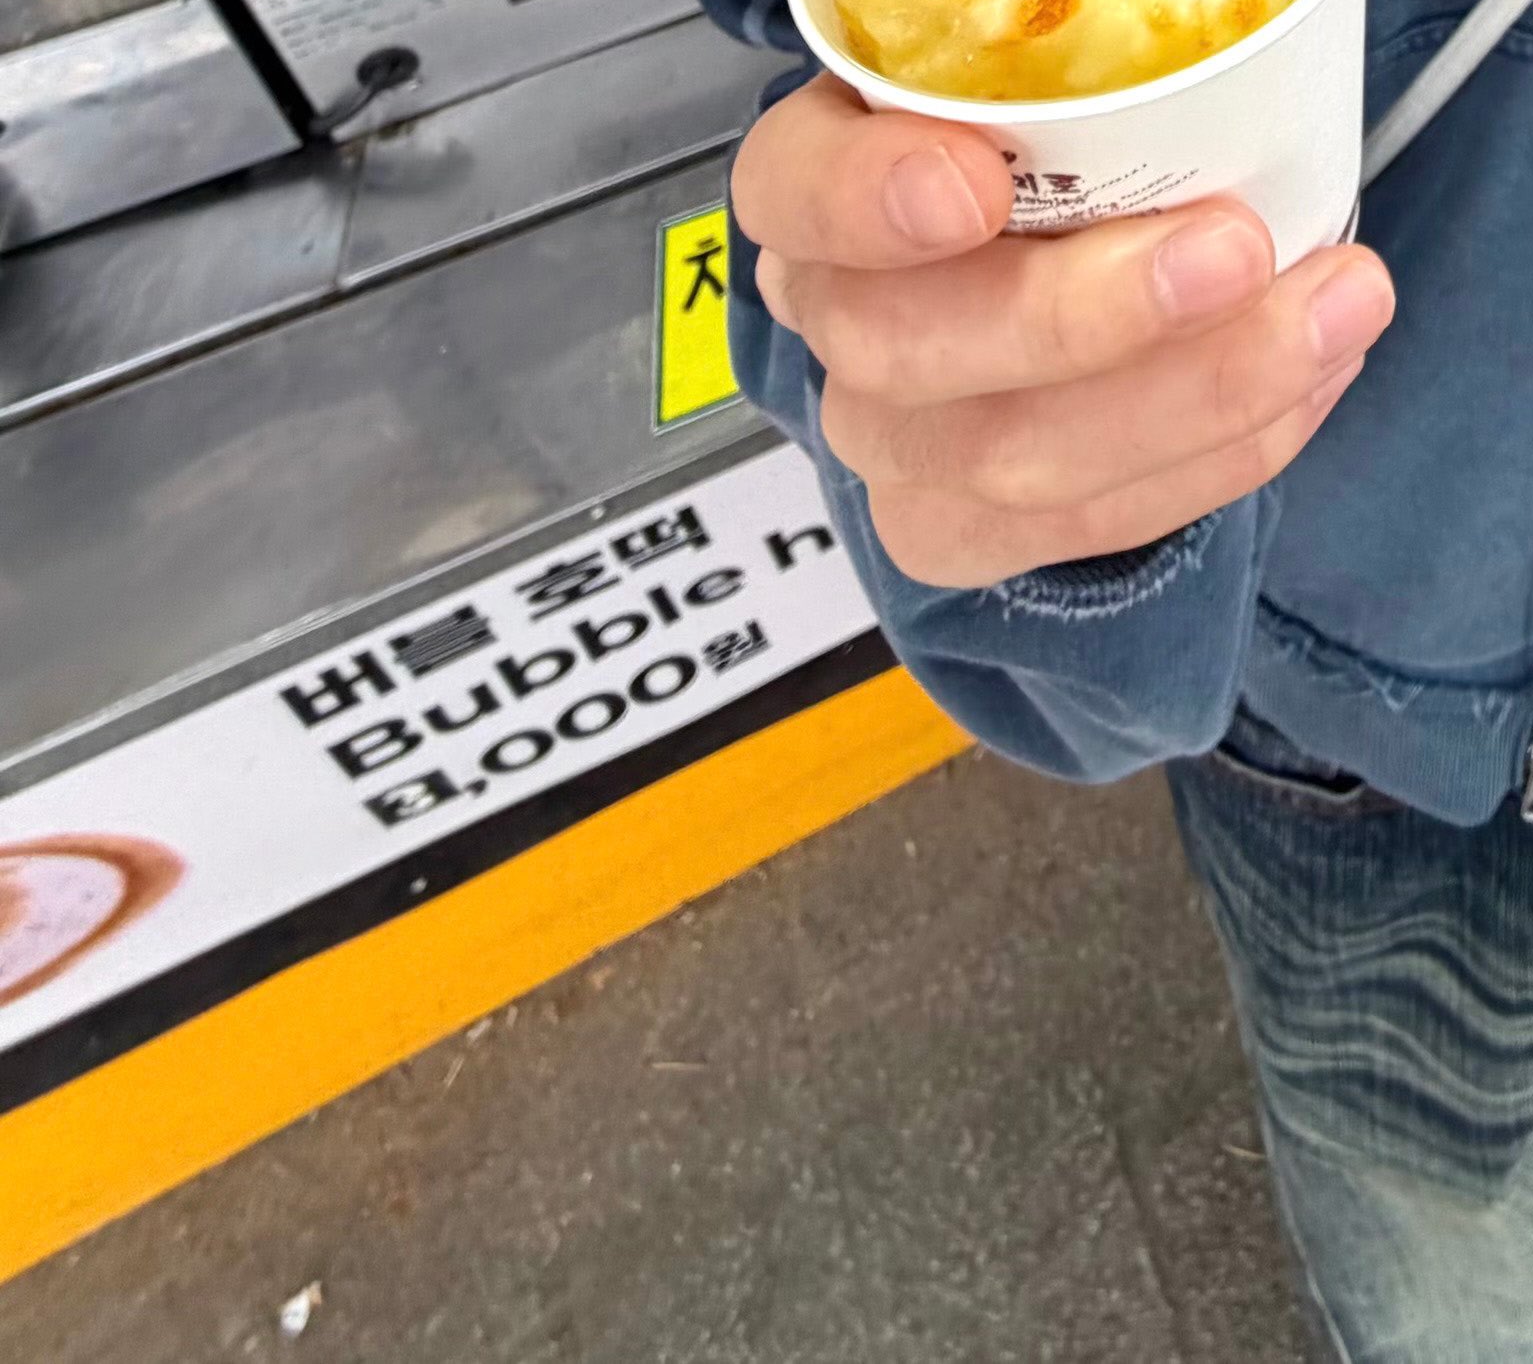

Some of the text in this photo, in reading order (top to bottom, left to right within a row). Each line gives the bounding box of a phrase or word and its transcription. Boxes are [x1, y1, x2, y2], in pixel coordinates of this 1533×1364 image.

[326, 525, 836, 780] Bubble h
[515, 506, 711, 623] 호떡
